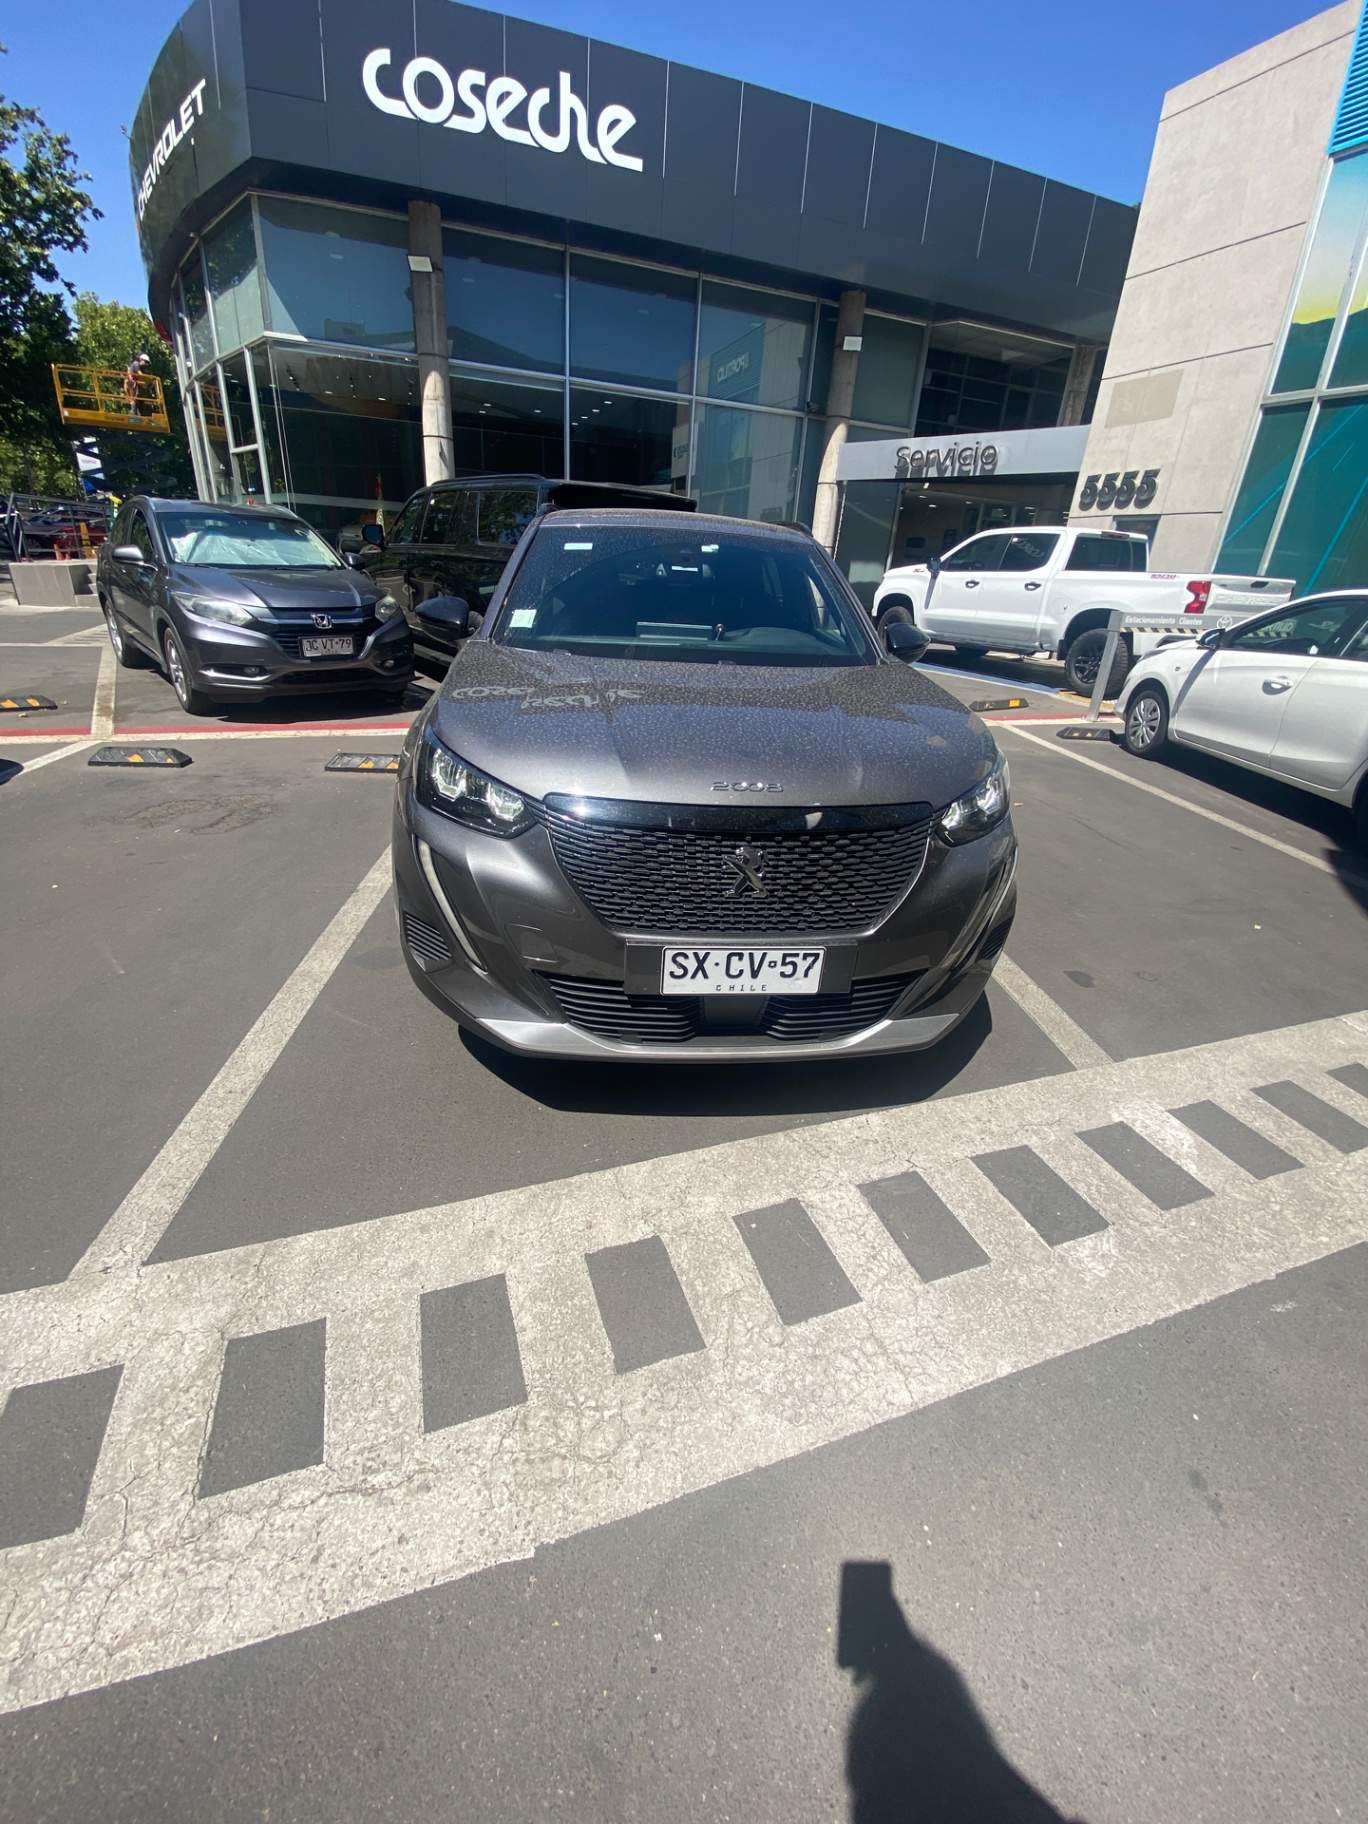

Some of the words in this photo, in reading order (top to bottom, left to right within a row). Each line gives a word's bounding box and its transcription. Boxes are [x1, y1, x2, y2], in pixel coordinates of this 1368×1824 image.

[137, 78, 206, 222] CHEVROLET
[894, 441, 998, 469] Servicio
[1078, 468, 1161, 511] 5555
[710, 781, 784, 793] 2008
